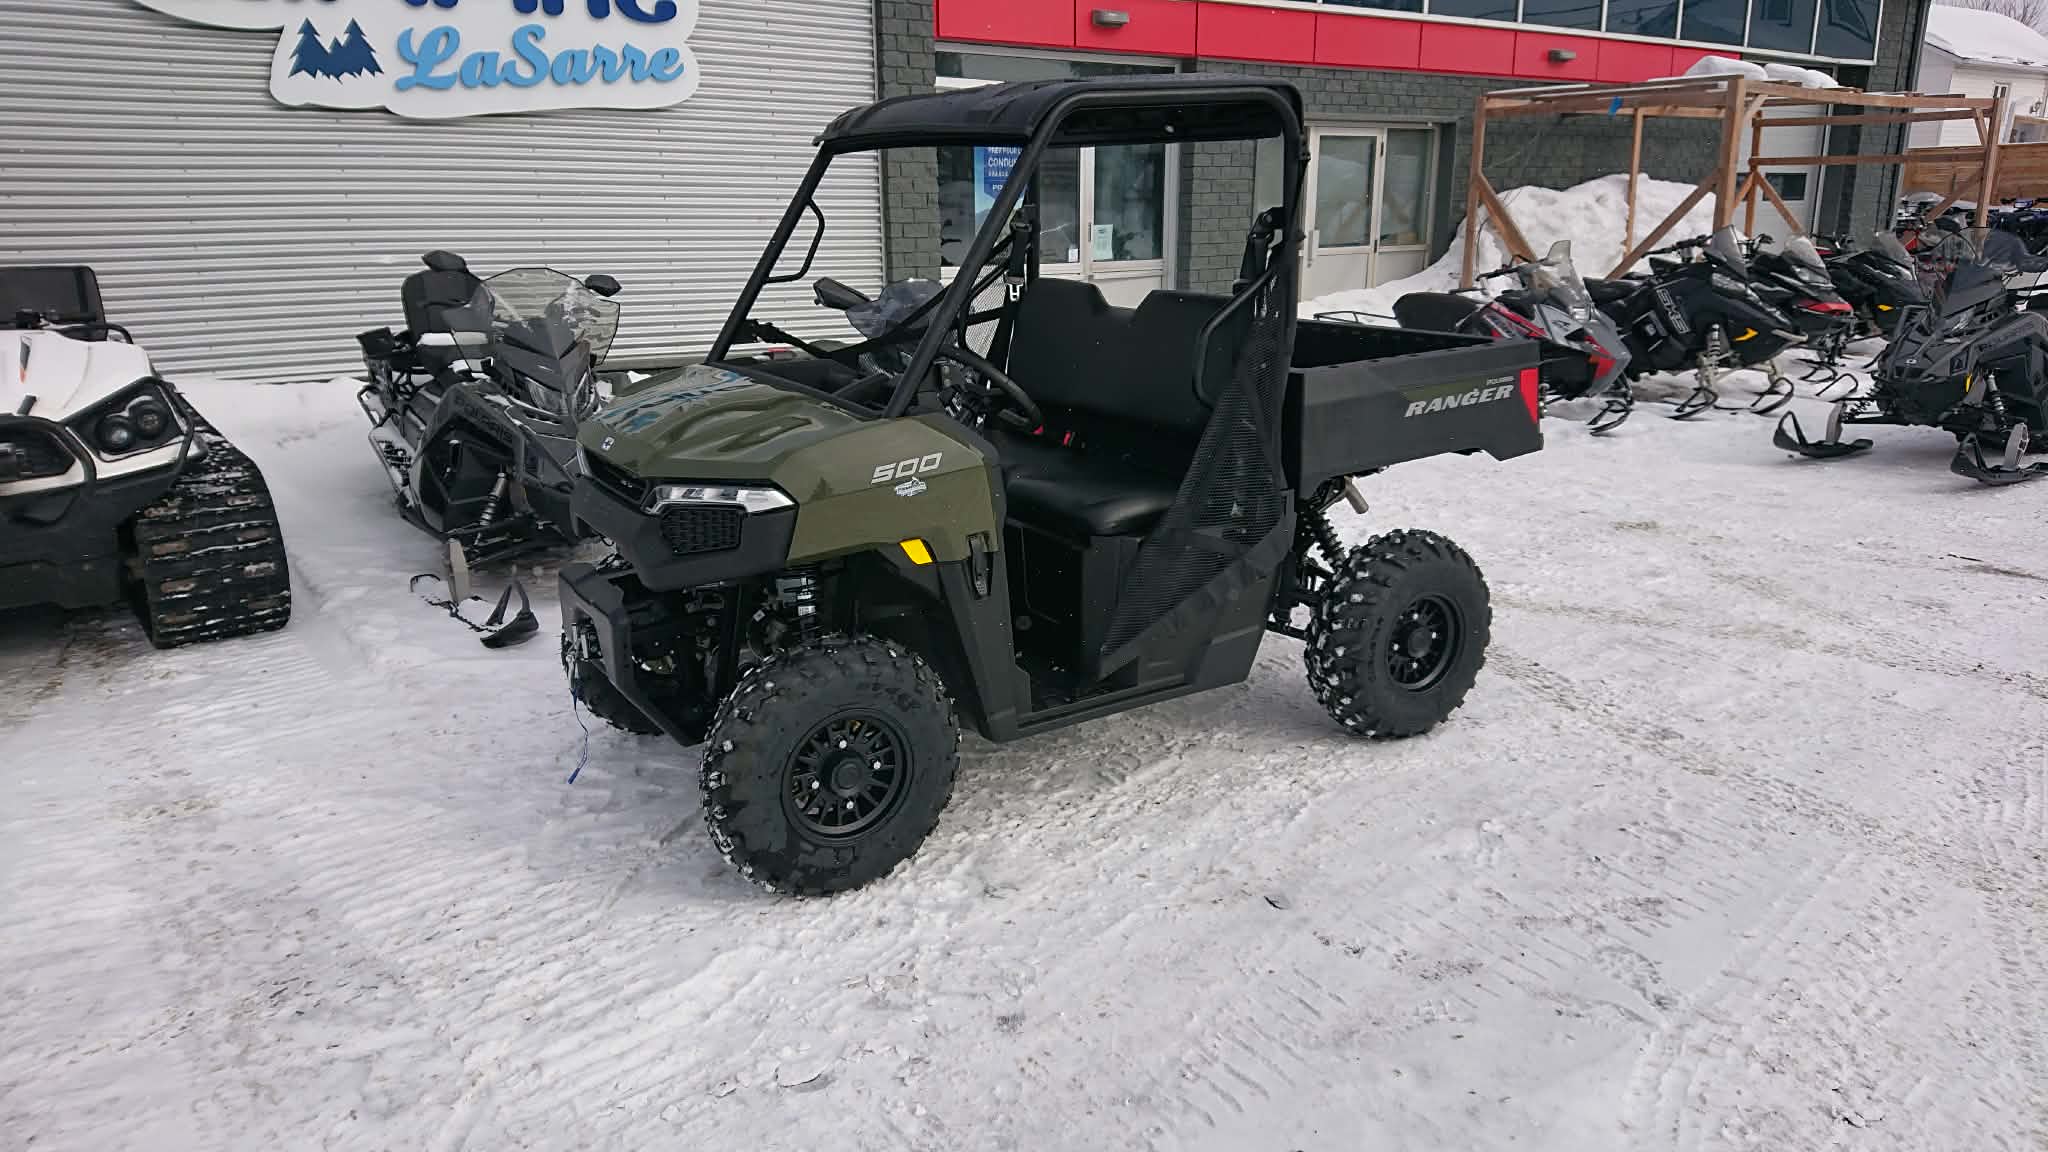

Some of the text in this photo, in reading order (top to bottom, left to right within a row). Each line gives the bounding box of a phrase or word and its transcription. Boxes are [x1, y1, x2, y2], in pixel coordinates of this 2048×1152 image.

[988, 157, 1017, 168] CONDU
[1403, 384, 1515, 418] RANGER
[871, 452, 942, 484] 500
